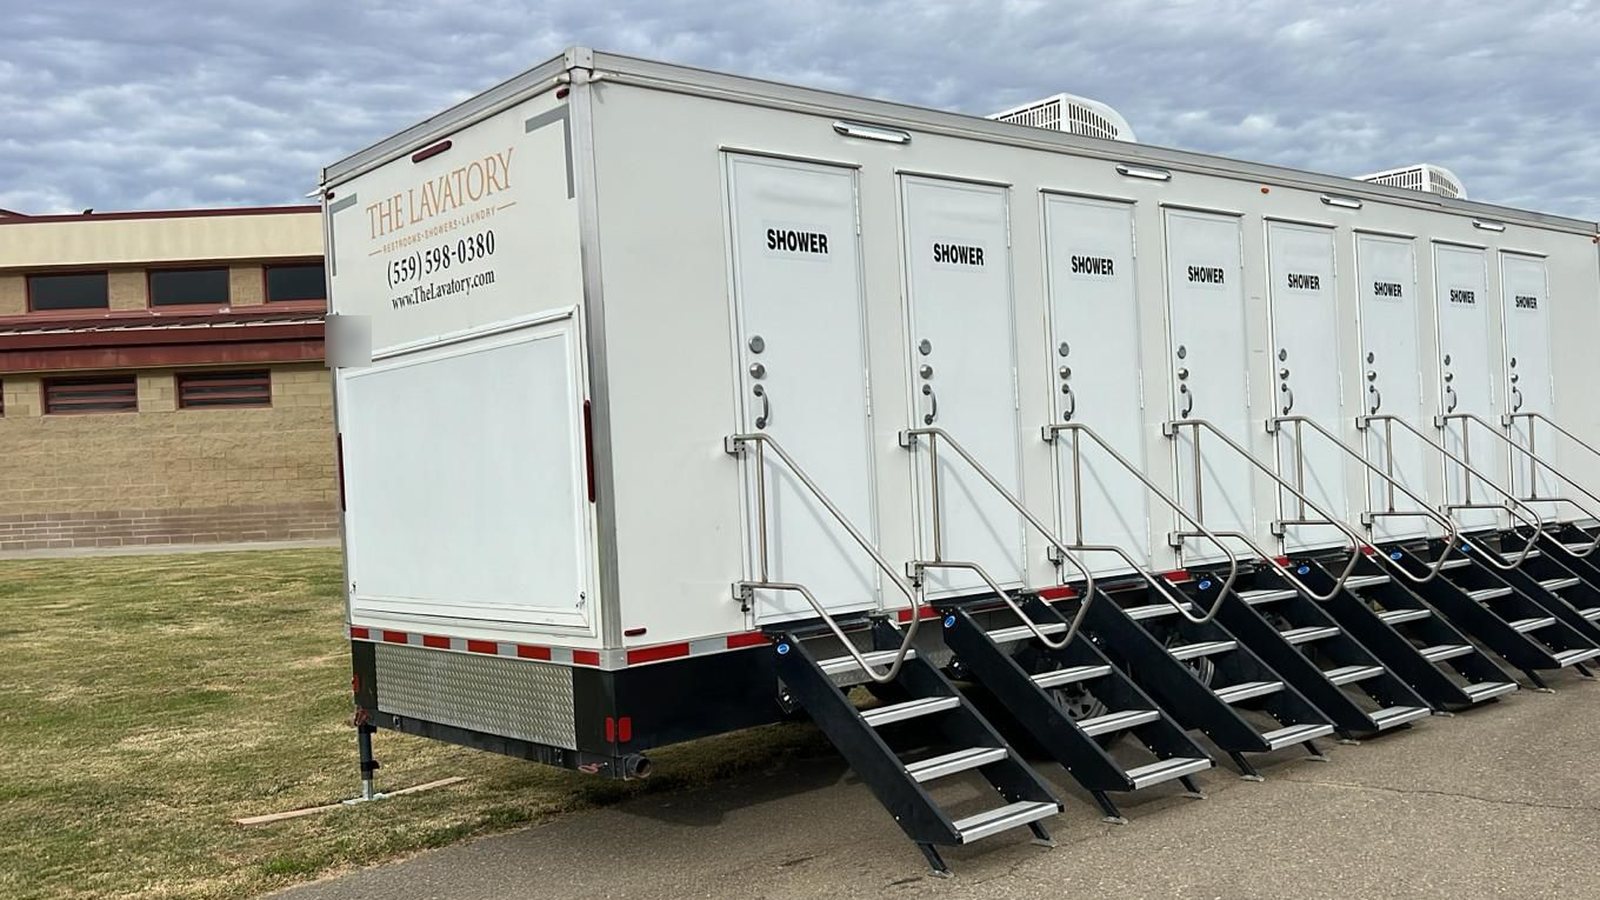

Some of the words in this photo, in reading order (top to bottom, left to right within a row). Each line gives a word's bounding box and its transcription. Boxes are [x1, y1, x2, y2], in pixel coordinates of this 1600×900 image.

[366, 193, 405, 240] THE
[408, 147, 514, 225] LAVATORY
[766, 228, 829, 254] SHOWER
[387, 251, 422, 289] (559)
[425, 230, 495, 275] 598-0380
[933, 242, 984, 266] SHOWER
[1071, 255, 1114, 276] SHOWER
[1187, 265, 1225, 284] SHOWER
[391, 270, 495, 310] www.TheLavatory.com
[1287, 273, 1320, 290] SHOWER
[1373, 281, 1402, 298] SHOWER
[1450, 289, 1476, 304] SHOWER
[1515, 295, 1537, 309] SHOWER
